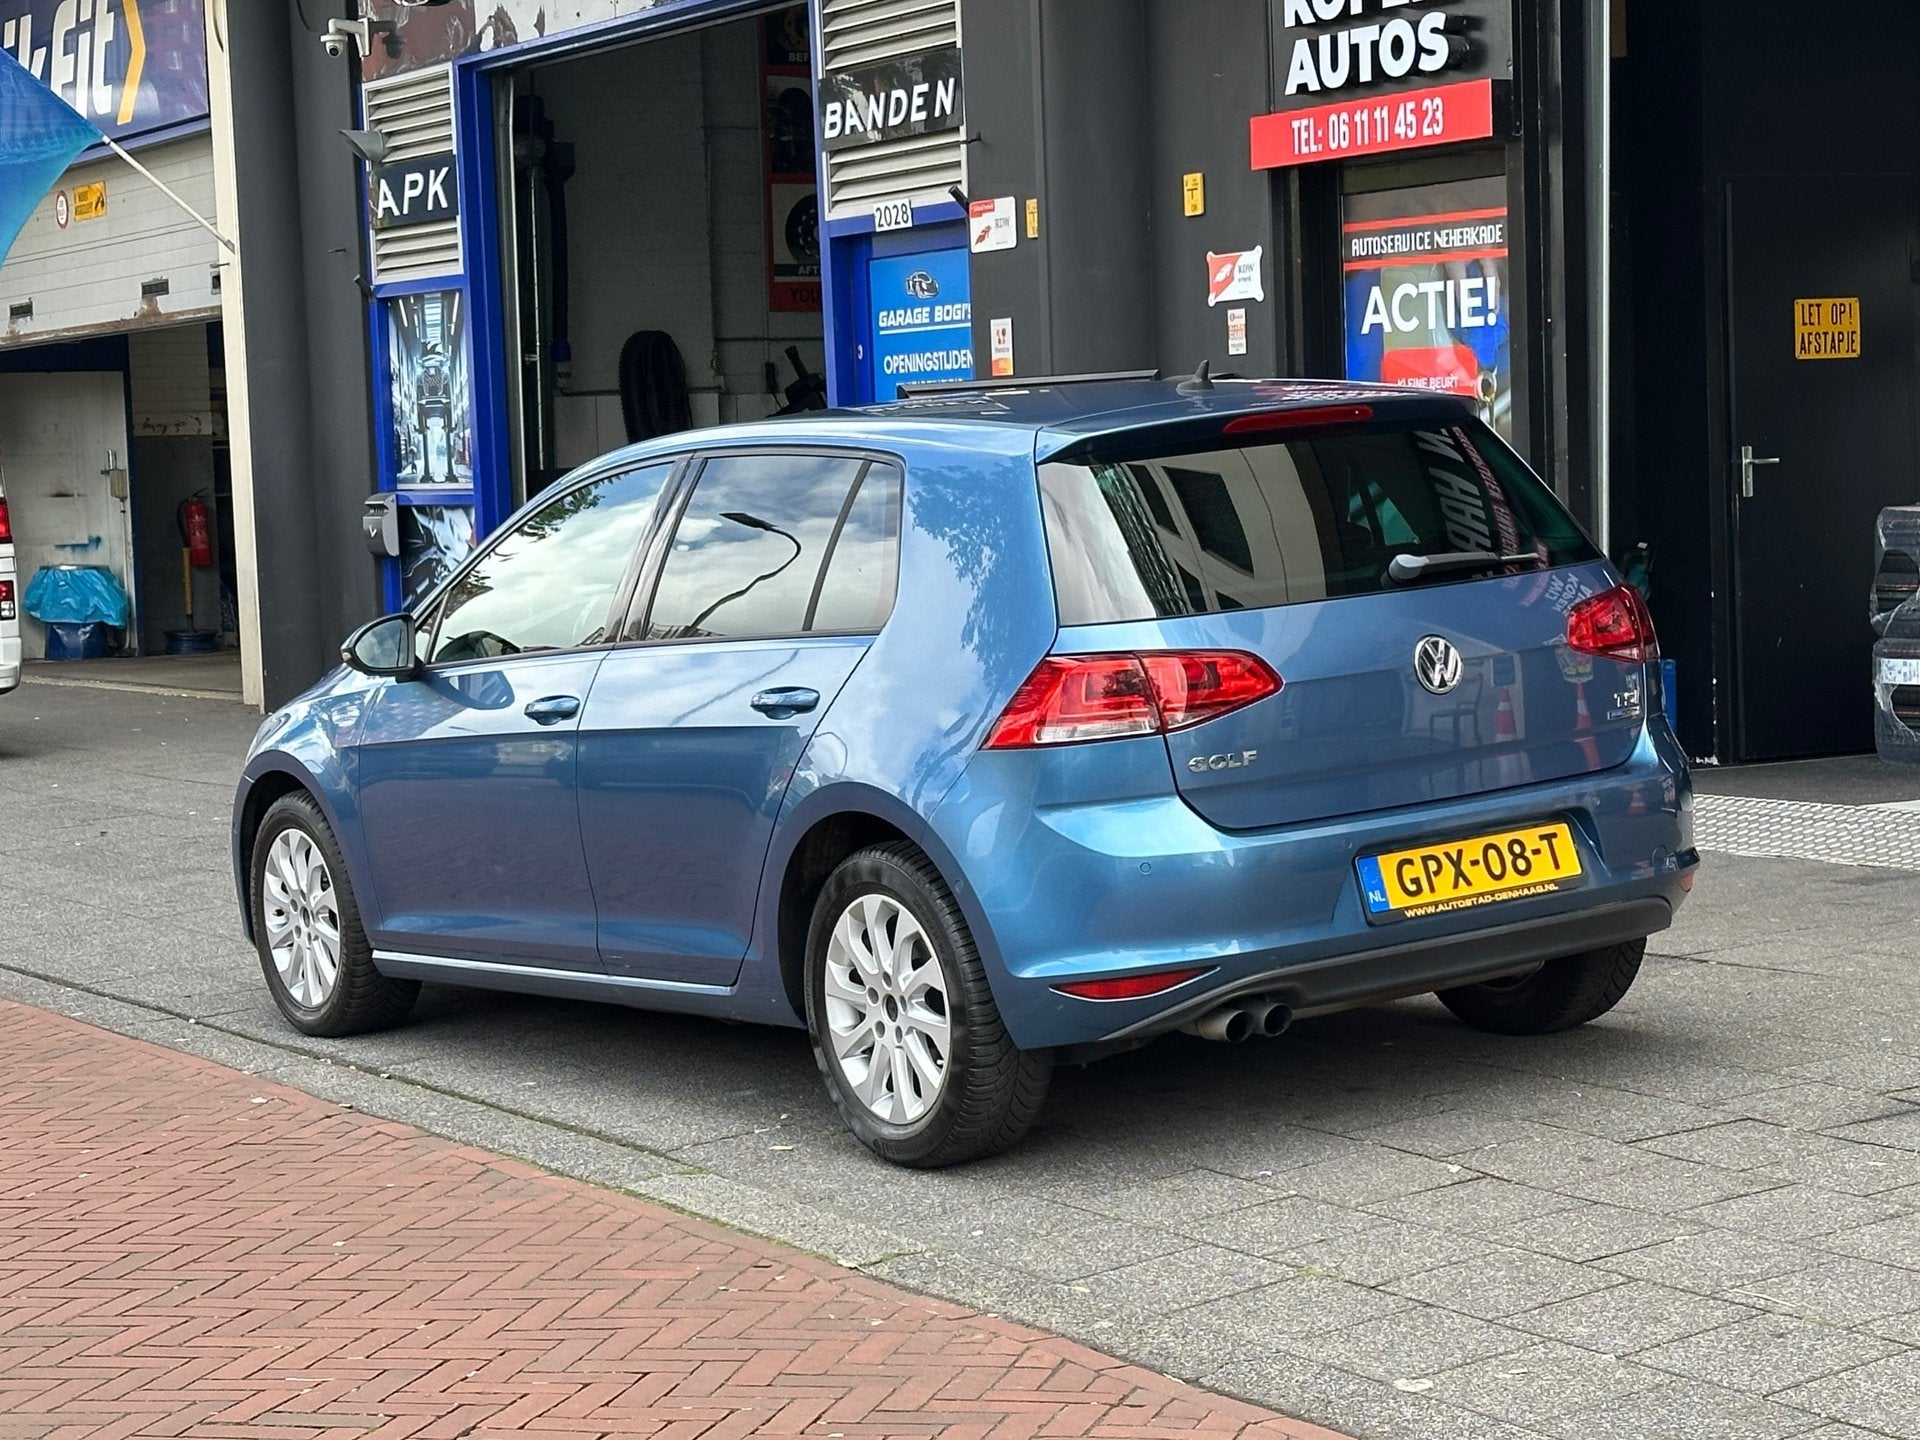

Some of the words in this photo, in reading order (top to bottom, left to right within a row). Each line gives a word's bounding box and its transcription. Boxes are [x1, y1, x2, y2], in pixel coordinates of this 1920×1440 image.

[1284, 11, 1449, 95] AUTOS
[824, 77, 955, 139] BANDEN
[1291, 117, 1323, 156] TEL:
[1328, 110, 1349, 151] 06
[1353, 108, 1369, 146] 11
[1374, 105, 1389, 143] 11
[1394, 100, 1417, 139] 45
[1422, 96, 1444, 136] 23
[377, 166, 450, 219] APK
[875, 203, 910, 228] 2028
[1433, 224, 1503, 249] NEHERKADE
[878, 306, 930, 328] GARAGE
[1361, 276, 1497, 335] ACTIE!
[1801, 303, 1822, 326] LET
[1831, 302, 1852, 325] OP!
[1799, 330, 1857, 355] AFSTAPJE
[883, 349, 973, 375] OPENINGSTIJDEN
[1429, 375, 1459, 389] BEURT
[1188, 749, 1258, 774] GOLF
[1395, 831, 1559, 898] GPX-08-T
[1368, 890, 1386, 904] NL
